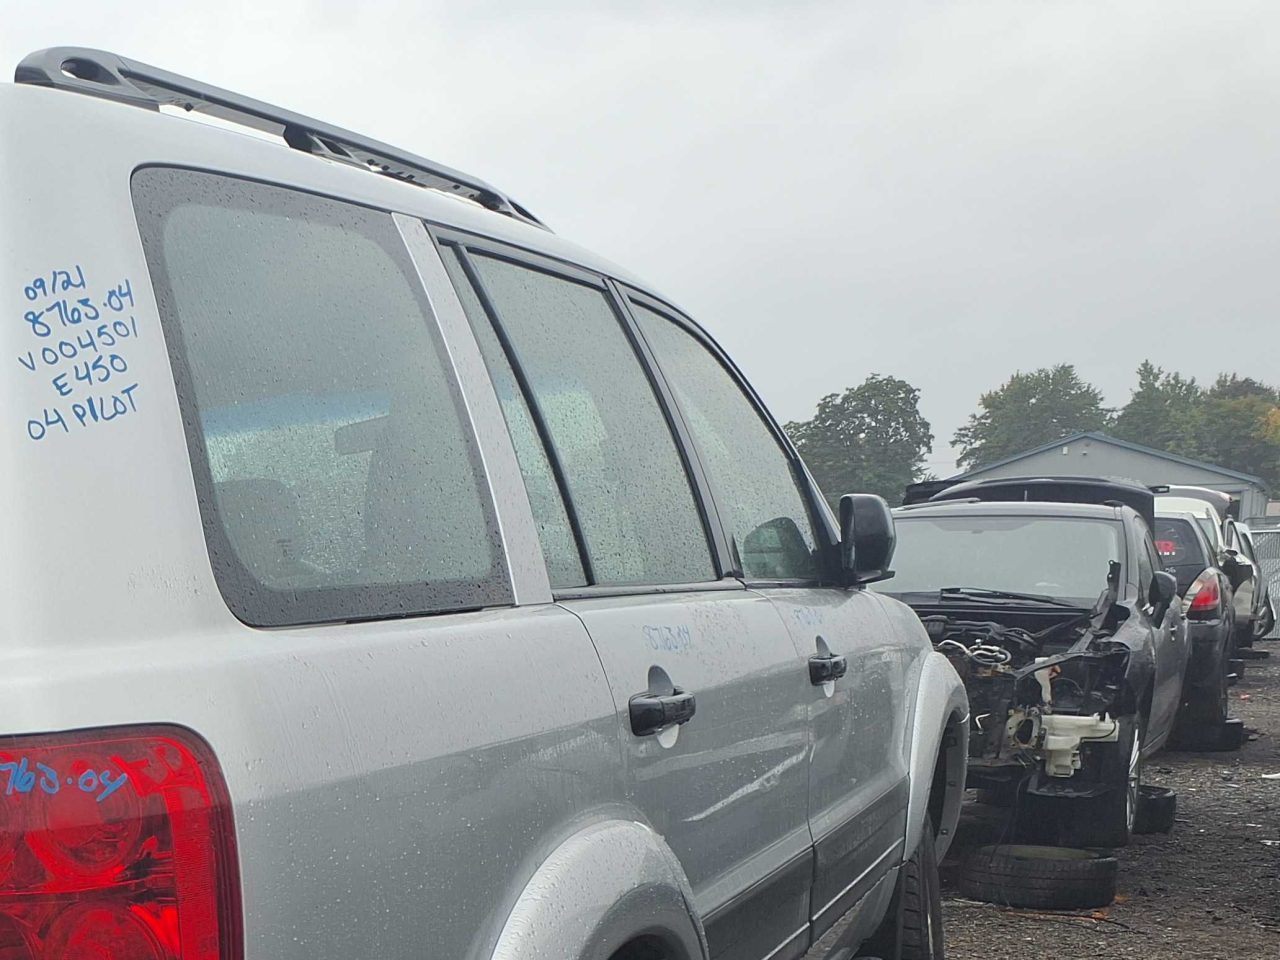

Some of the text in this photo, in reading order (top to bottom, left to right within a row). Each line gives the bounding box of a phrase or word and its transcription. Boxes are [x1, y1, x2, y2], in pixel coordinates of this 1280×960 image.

[18, 316, 138, 371] V004501
[52, 355, 128, 396] E450
[71, 383, 138, 427] PILOT
